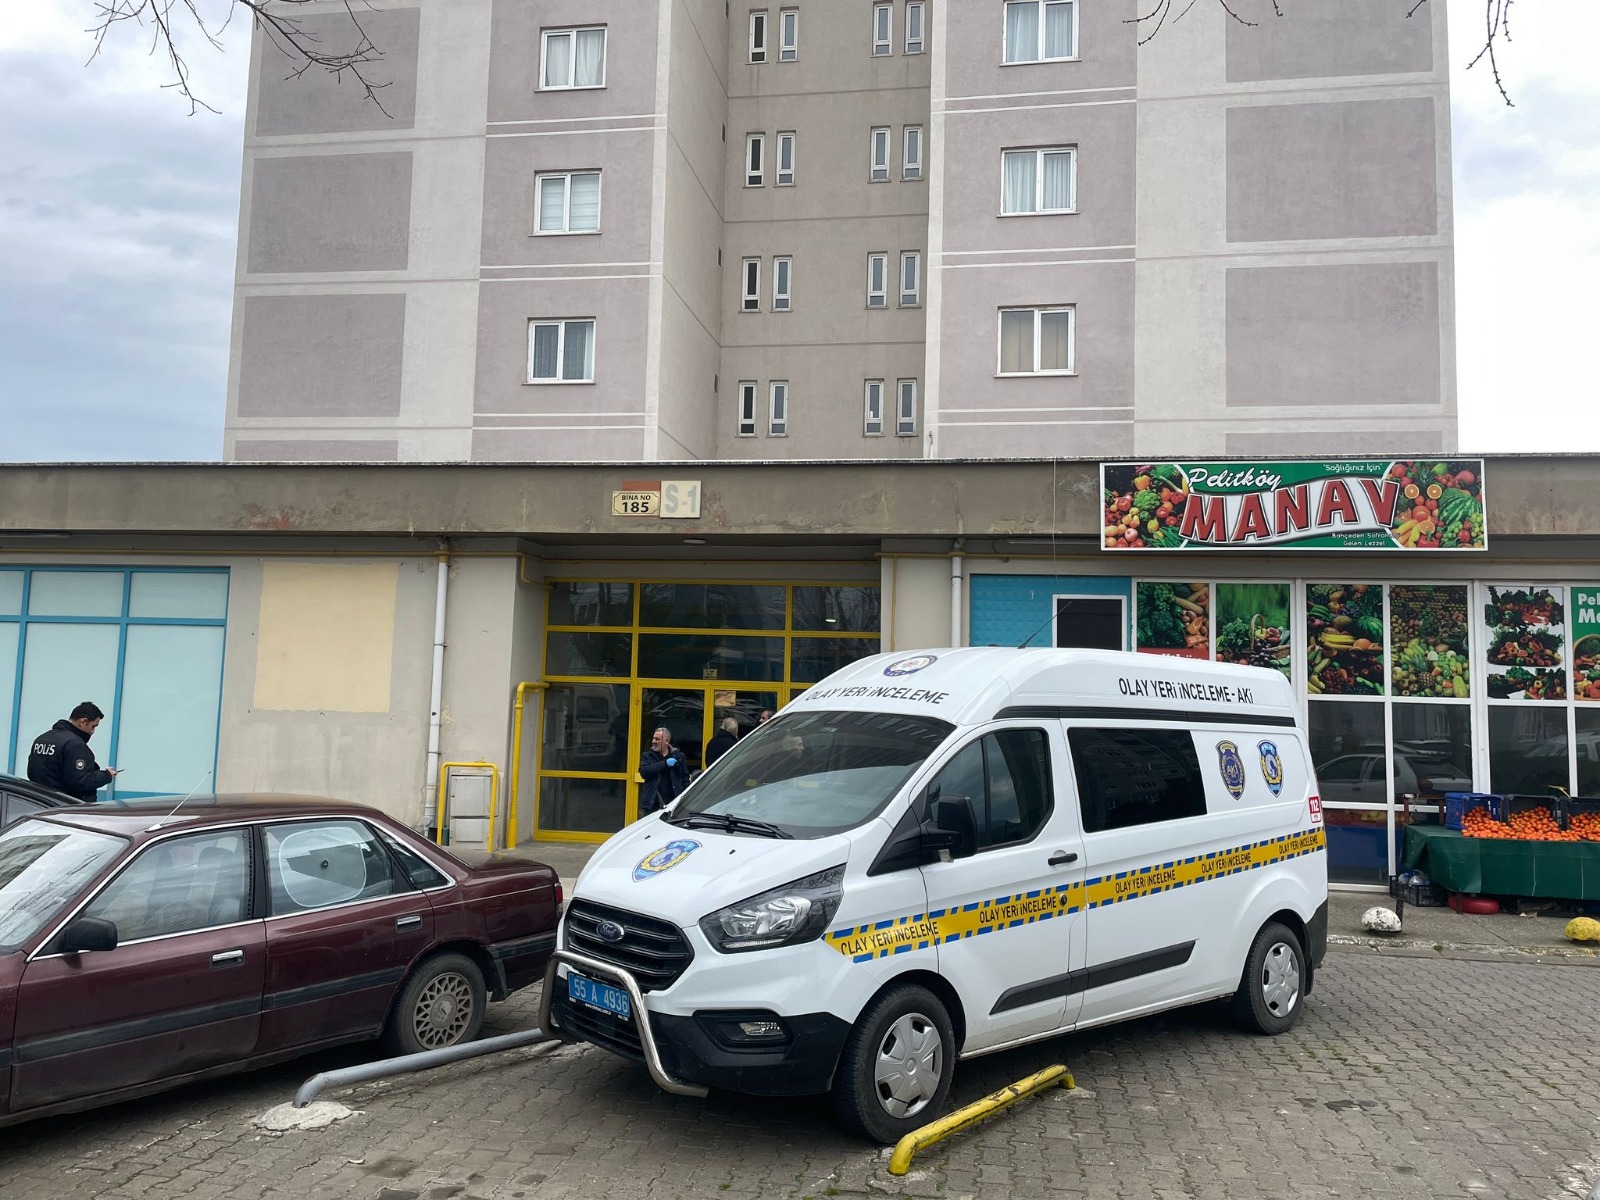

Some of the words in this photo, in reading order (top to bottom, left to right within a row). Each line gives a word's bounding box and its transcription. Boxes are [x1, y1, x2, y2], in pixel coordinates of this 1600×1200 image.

[1188, 467, 1282, 492] Pelitköy
[664, 484, 697, 513] S-1
[622, 501, 649, 513] 185
[1179, 478, 1400, 543] MANAV
[1331, 532, 1365, 540] Bahçeden
[805, 687, 840, 701] OLAY
[1119, 677, 1149, 697] OLAY
[1310, 799, 1319, 812] 112
[1116, 881, 1131, 893] OLAY
[980, 908, 1000, 923] OLAY
[574, 978, 586, 998] 55
[591, 984, 598, 1003] A
[603, 989, 628, 1013] 4936
